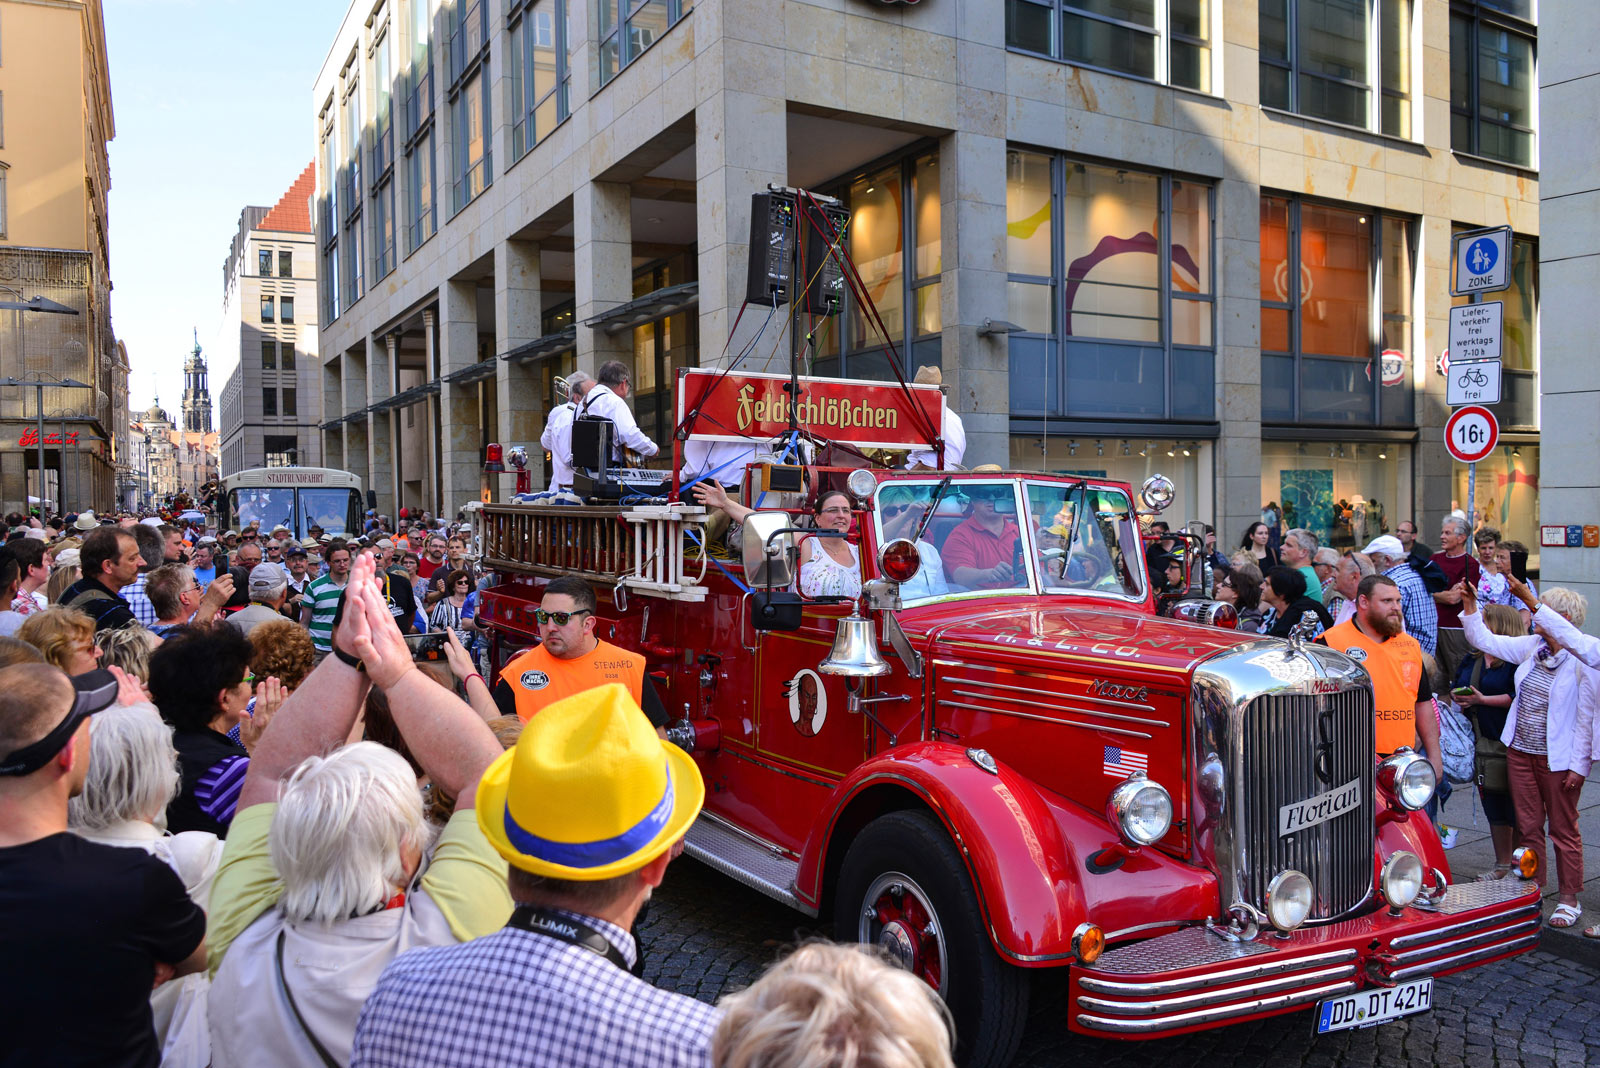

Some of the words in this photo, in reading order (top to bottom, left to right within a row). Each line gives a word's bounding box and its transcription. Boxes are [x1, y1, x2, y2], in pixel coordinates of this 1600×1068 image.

[1468, 275, 1493, 288] ZONE
[1462, 308, 1489, 318] Liefer-
[1460, 317, 1491, 326] verkehr
[1468, 327, 1482, 335] frei
[1456, 337, 1494, 346] werktags
[1464, 390, 1481, 399] frei
[1458, 424, 1484, 444] 16t
[267, 473, 324, 484] STADTRUNDFAHRT
[488, 599, 533, 625] NAVES
[594, 660, 633, 669] STEWARD
[1086, 678, 1148, 702] Mack
[1311, 680, 1341, 694] Mack
[1375, 709, 1415, 721] RESDE
[1286, 786, 1358, 829] Florian
[530, 914, 579, 939] LUMIX
[1330, 999, 1356, 1025] DD
[1368, 990, 1392, 1017] DT
[1394, 982, 1430, 1011] 42H
